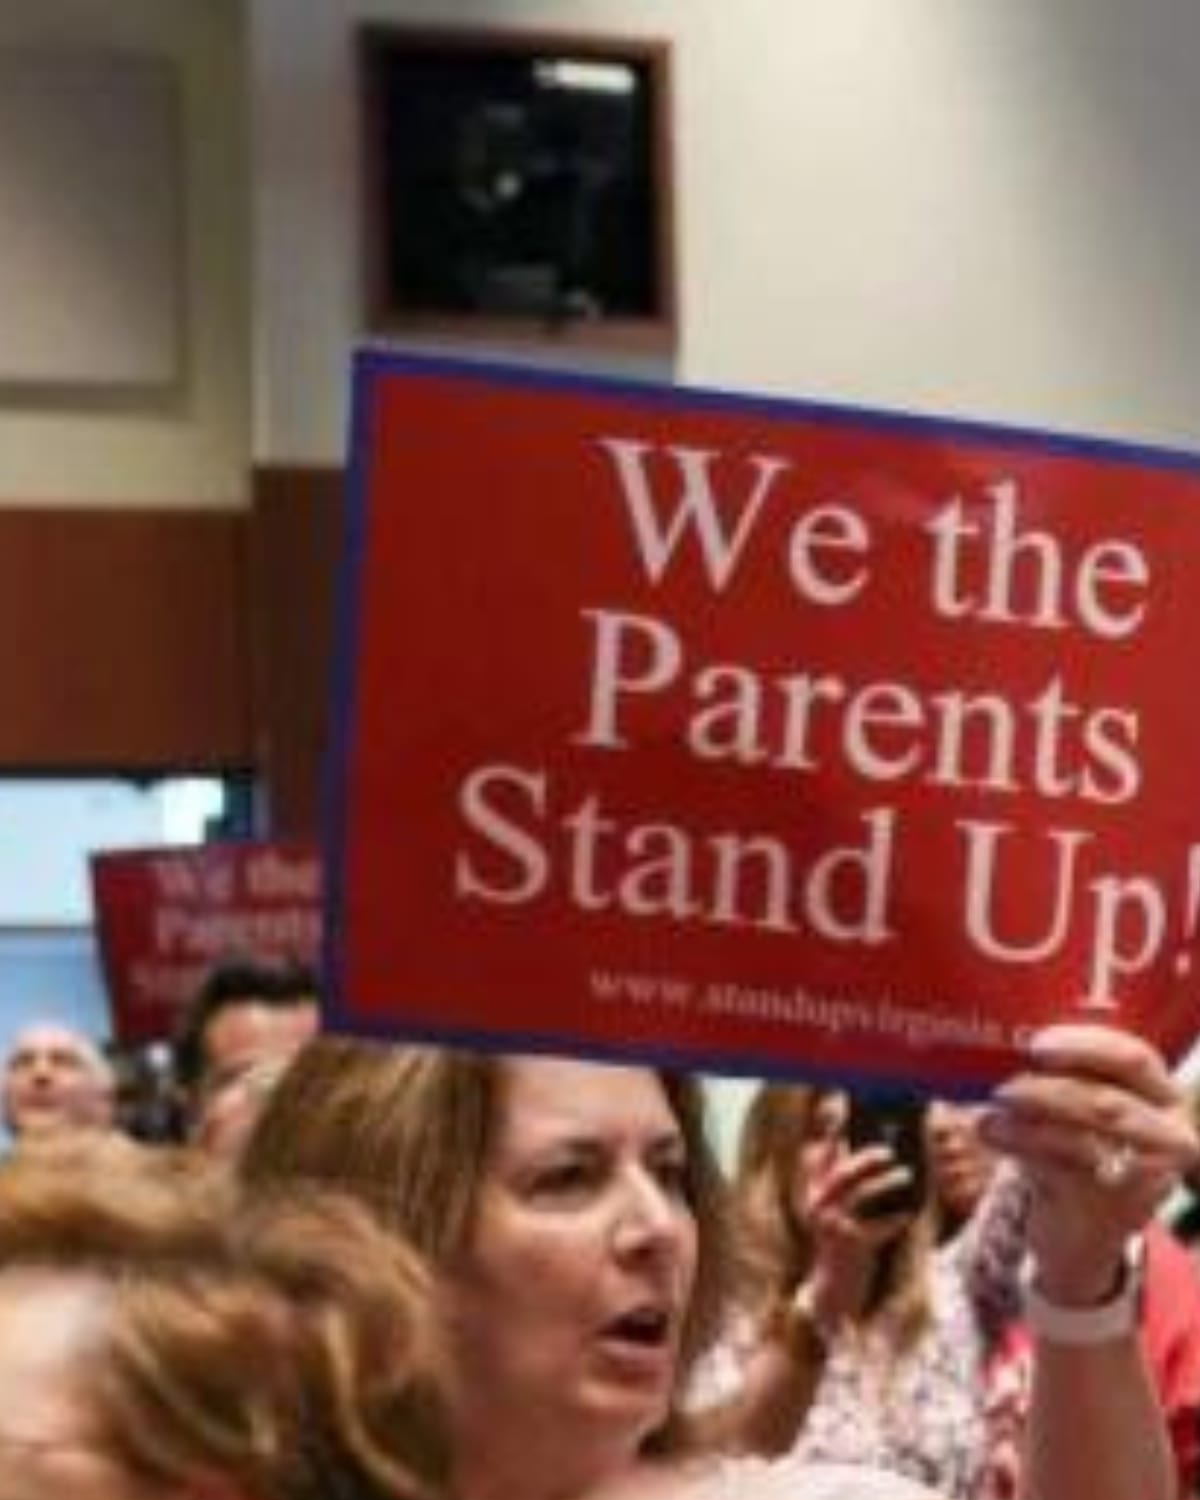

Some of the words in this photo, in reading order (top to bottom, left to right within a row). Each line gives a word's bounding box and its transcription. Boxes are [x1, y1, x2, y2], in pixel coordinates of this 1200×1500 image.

[603, 437, 870, 606] We
[924, 476, 1152, 640] the
[572, 606, 1142, 806] Parents
[455, 764, 896, 946] Stand
